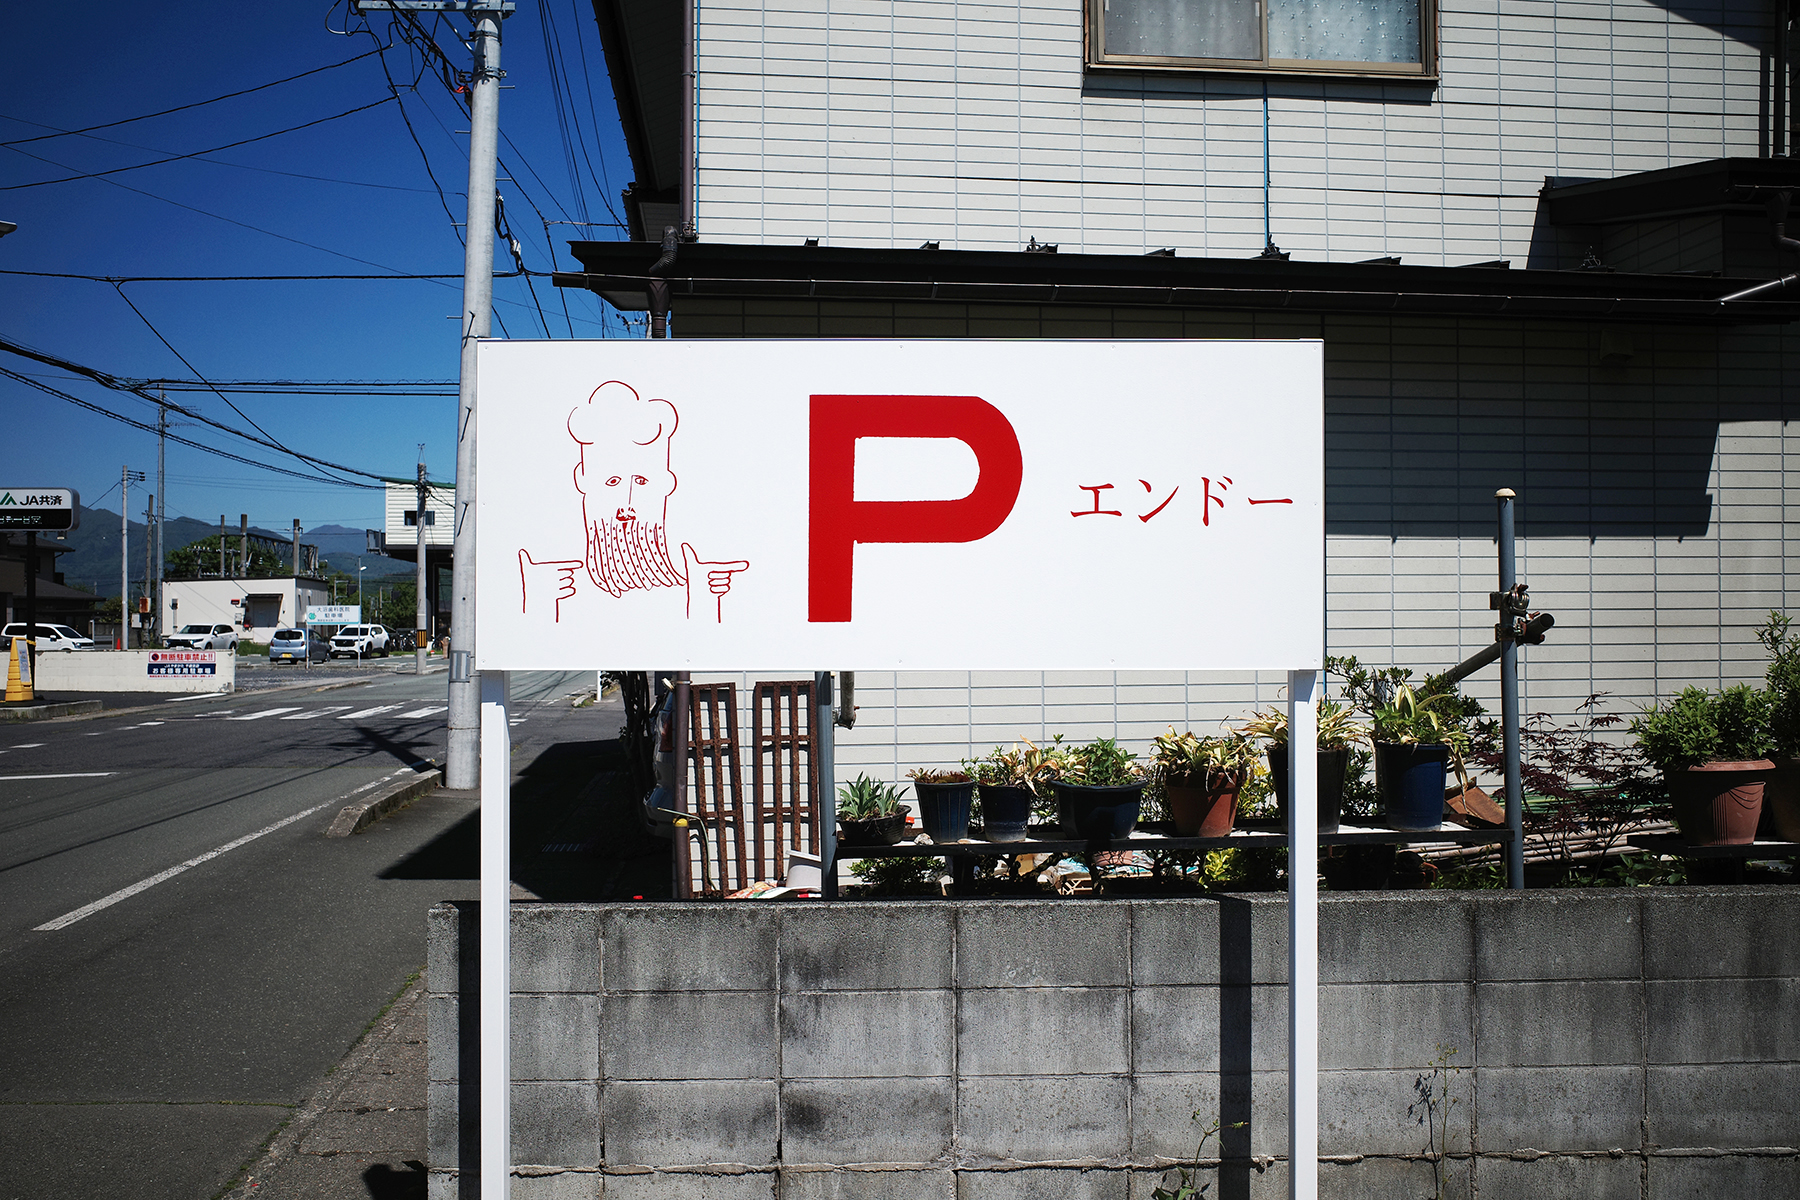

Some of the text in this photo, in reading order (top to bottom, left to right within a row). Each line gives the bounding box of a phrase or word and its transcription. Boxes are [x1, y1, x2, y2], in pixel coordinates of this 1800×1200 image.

[20, 495, 62, 506] JA共済
[808, 394, 1023, 622] P
[1070, 475, 1294, 527] エンドー
